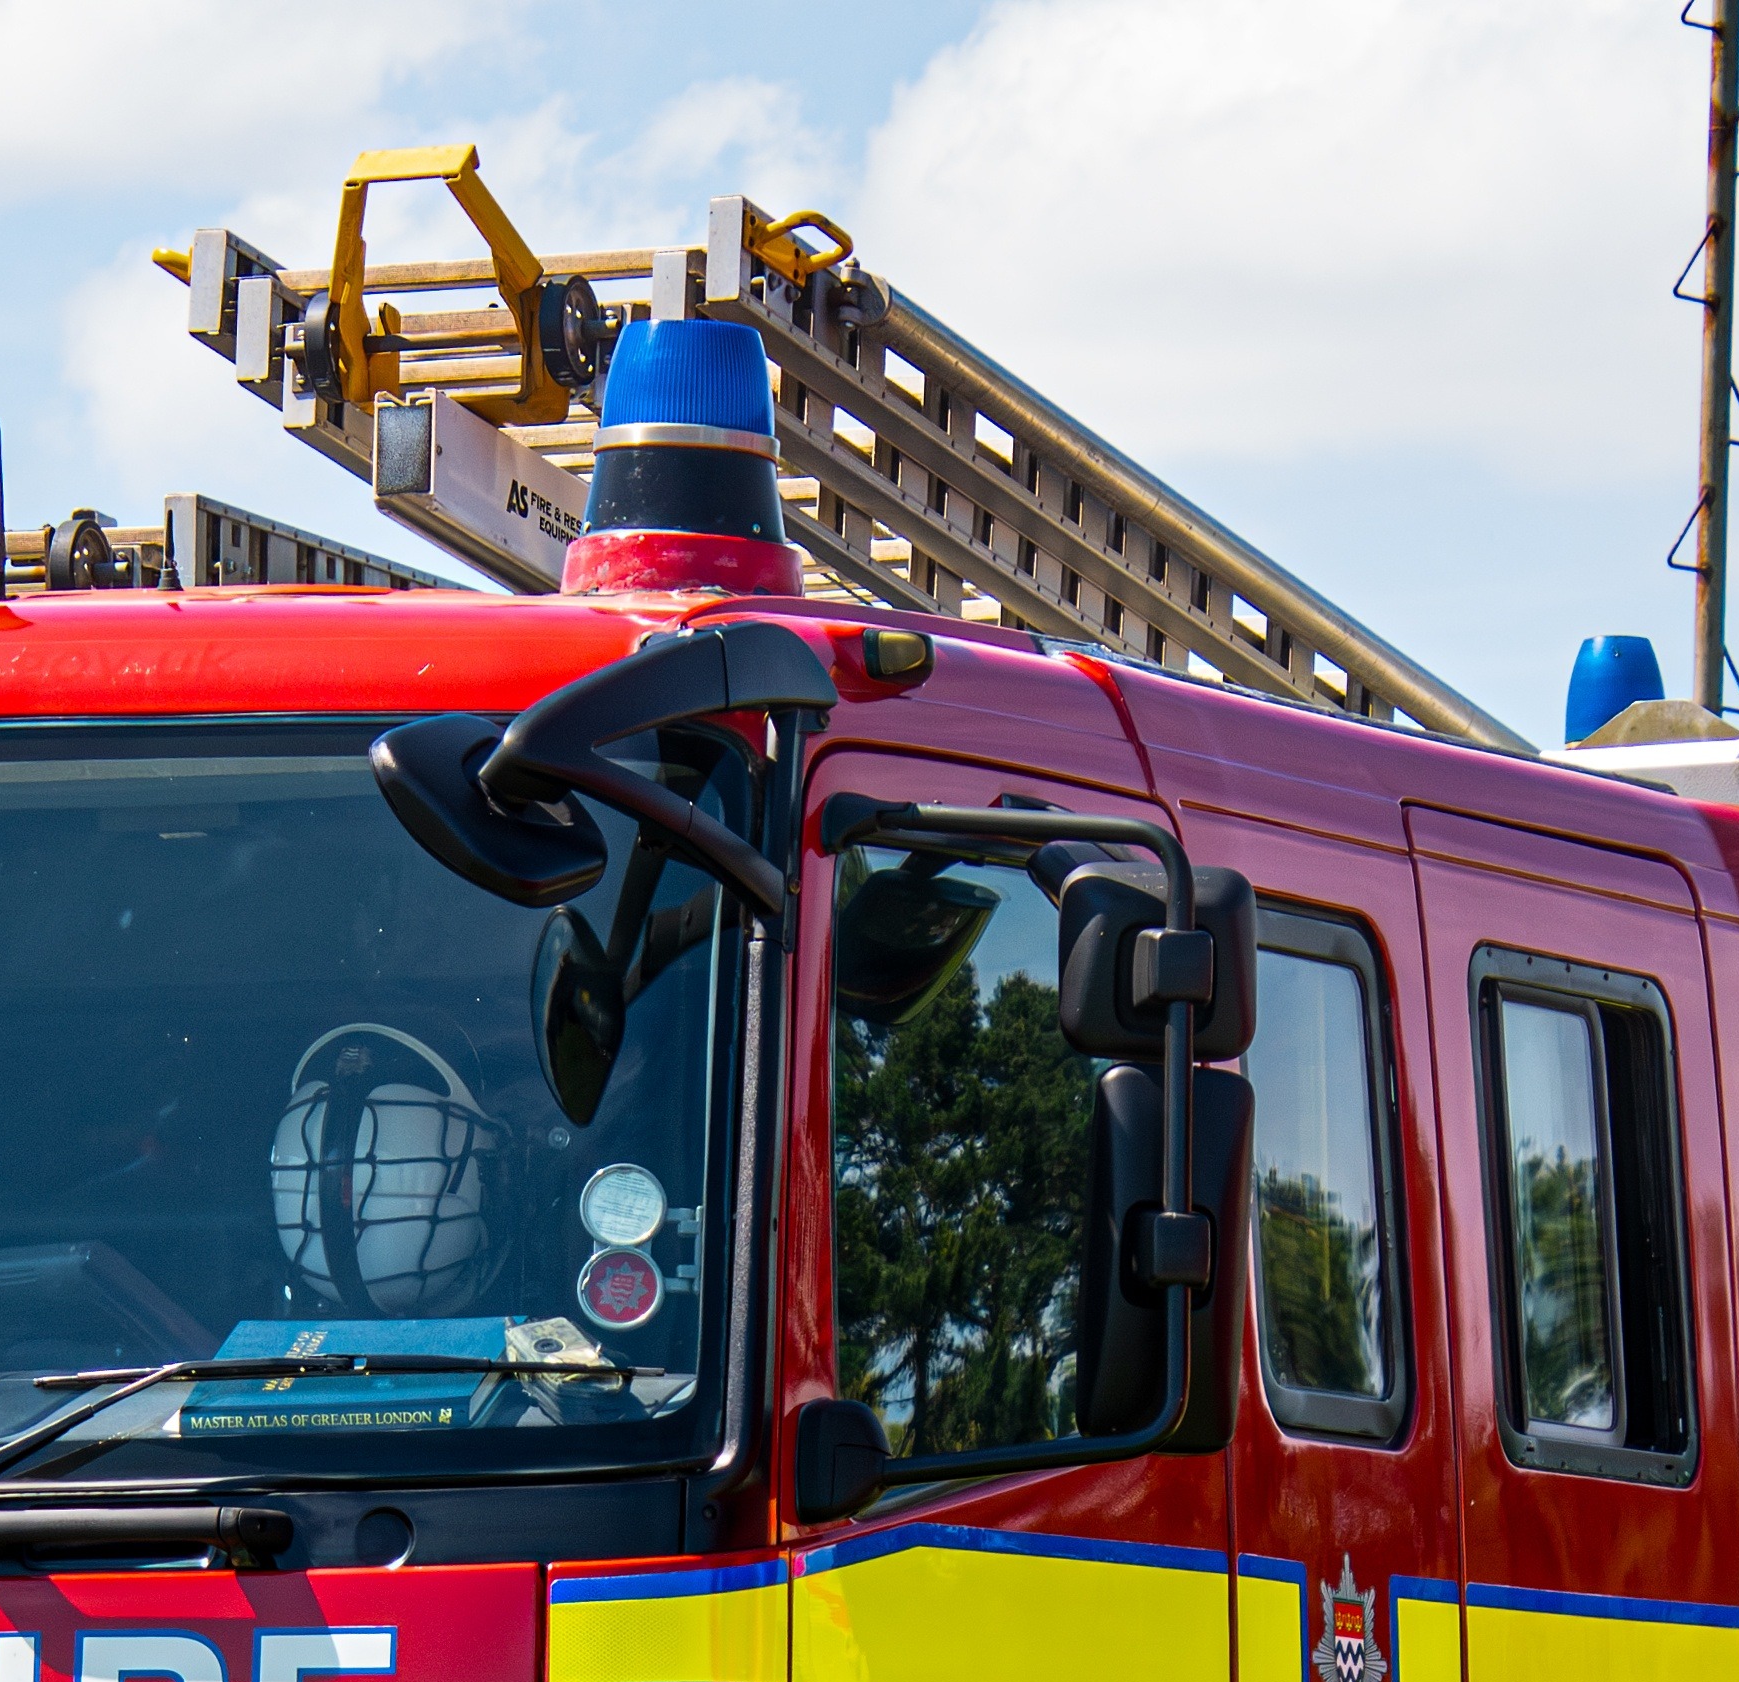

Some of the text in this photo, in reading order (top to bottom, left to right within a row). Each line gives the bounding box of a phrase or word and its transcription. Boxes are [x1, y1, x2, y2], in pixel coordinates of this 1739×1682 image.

[506, 479, 582, 535] AS FIRE & RES
[539, 516, 578, 547] EQUIPM
[191, 1411, 432, 1430] MASTER ATLAS OF GREATER LONDON
